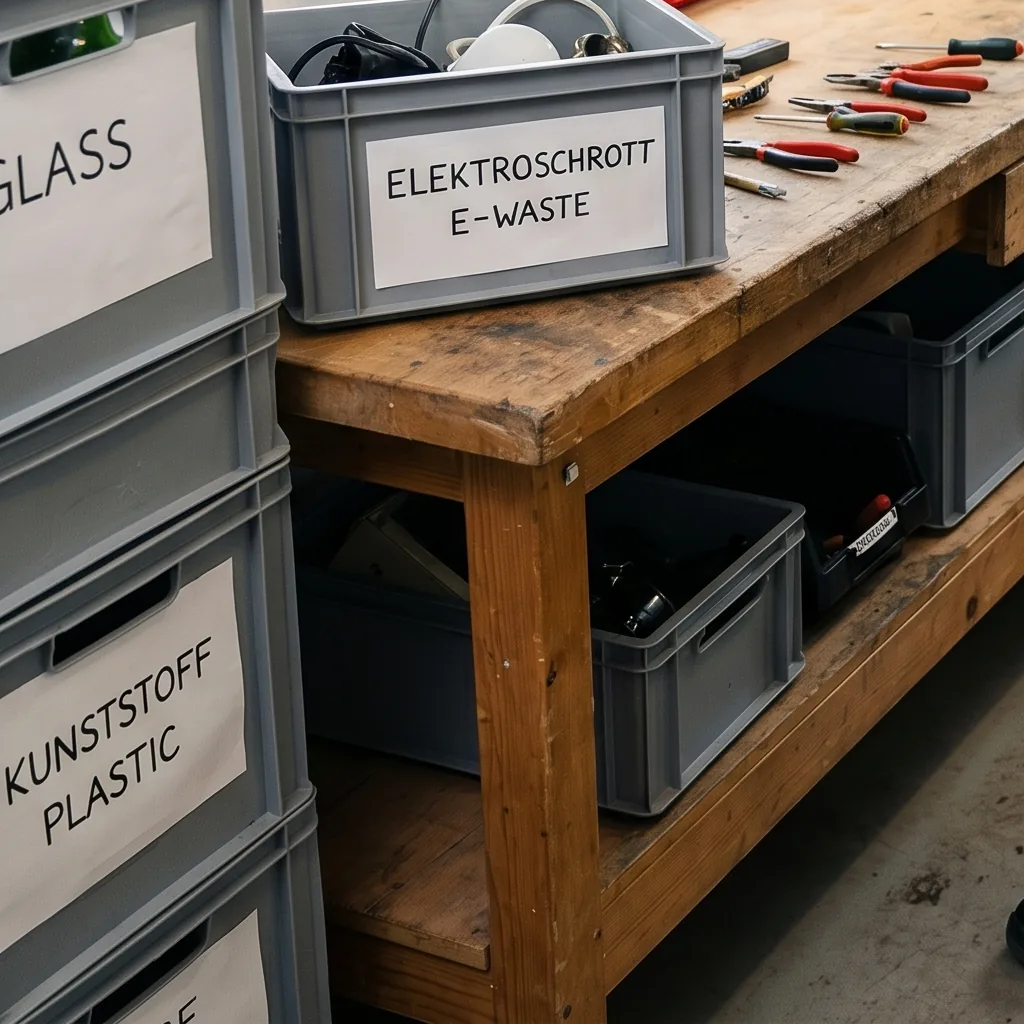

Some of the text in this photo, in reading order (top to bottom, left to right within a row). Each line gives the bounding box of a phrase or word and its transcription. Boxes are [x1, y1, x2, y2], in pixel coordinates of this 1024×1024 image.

[387, 138, 656, 200] ELEKTROSCHROTT
[451, 191, 590, 236] E-WASTE
[5, 636, 212, 806] KUNSTSTOFF
[43, 724, 180, 847] PLASTIC
